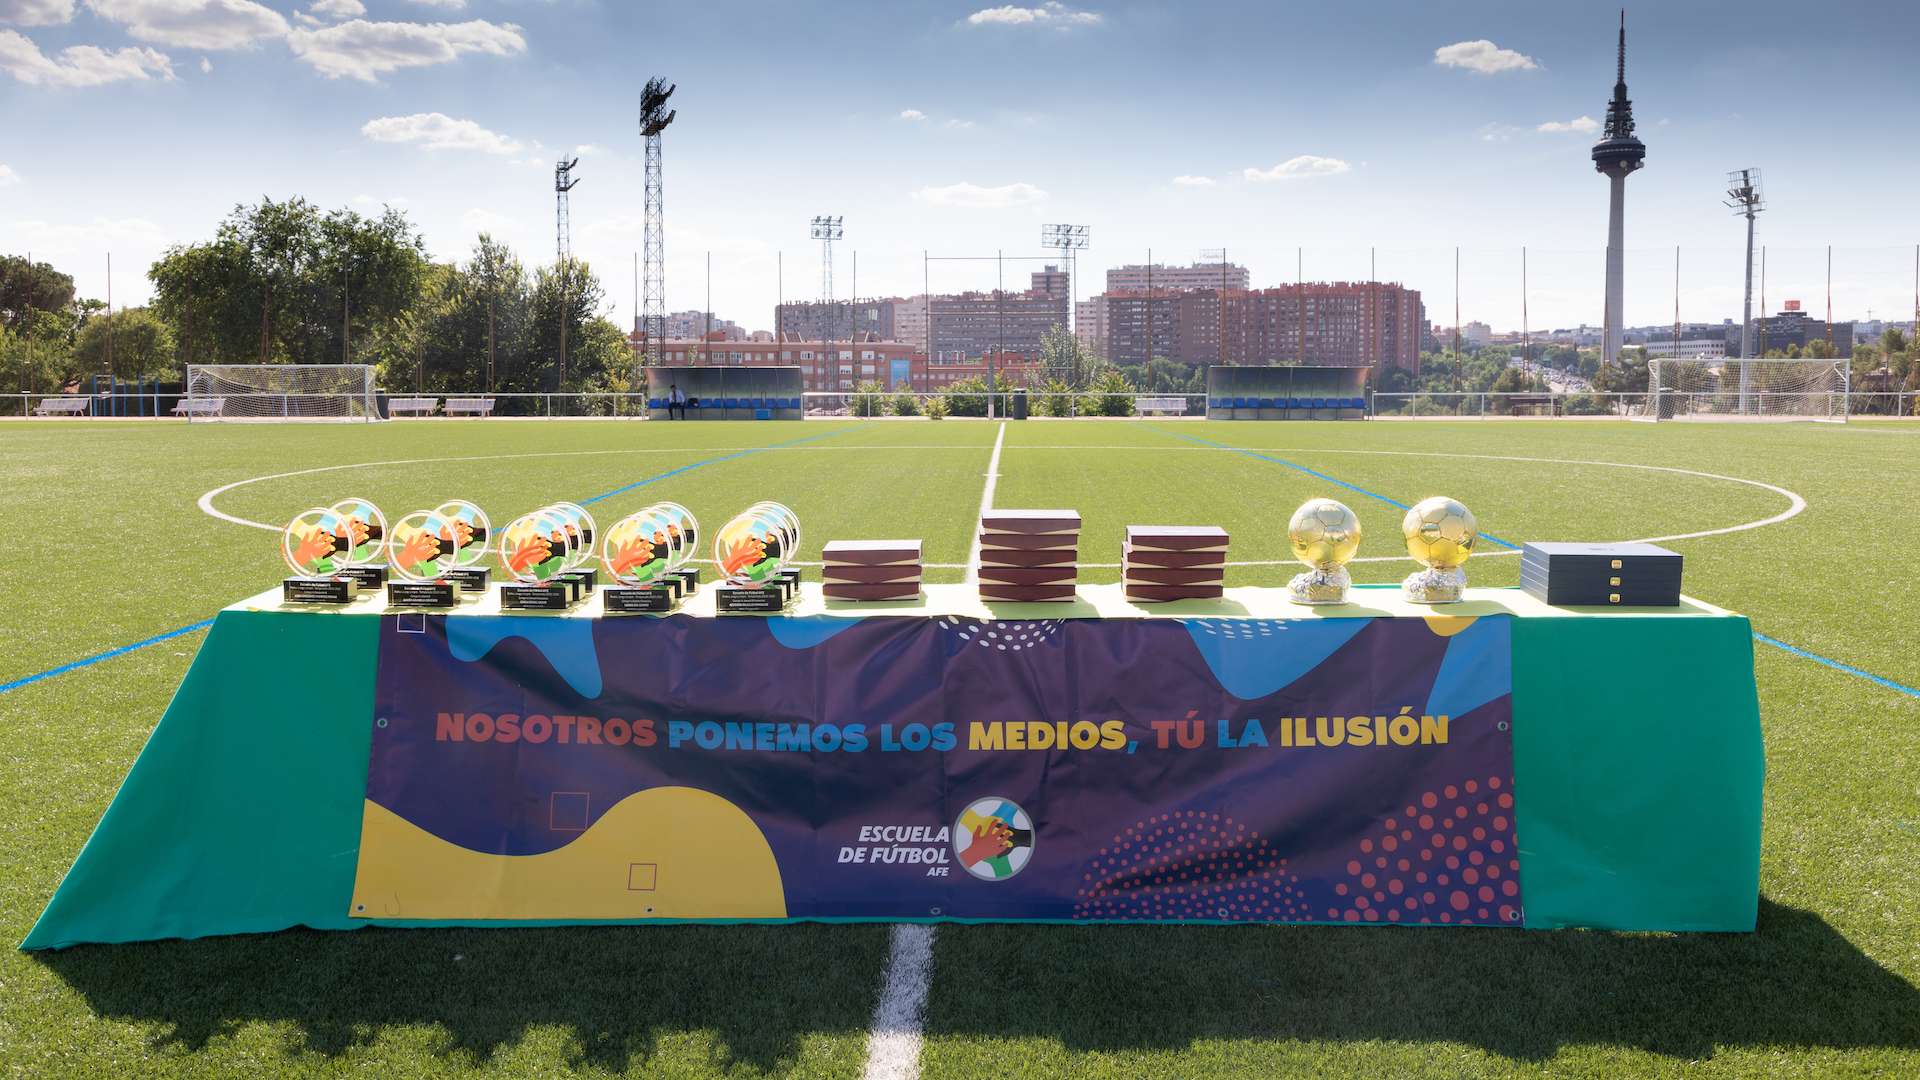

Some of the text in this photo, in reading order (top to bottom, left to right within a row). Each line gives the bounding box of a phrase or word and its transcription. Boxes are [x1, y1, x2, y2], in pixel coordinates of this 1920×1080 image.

[436, 706, 1449, 755] NOSOTROS PONEMOS LOS MEDIOS, TÚ LA ILUSIÓN
[858, 825, 950, 843] ESCUELA
[837, 843, 950, 864] DE FÚTBOL
[926, 866, 950, 877] AFE
